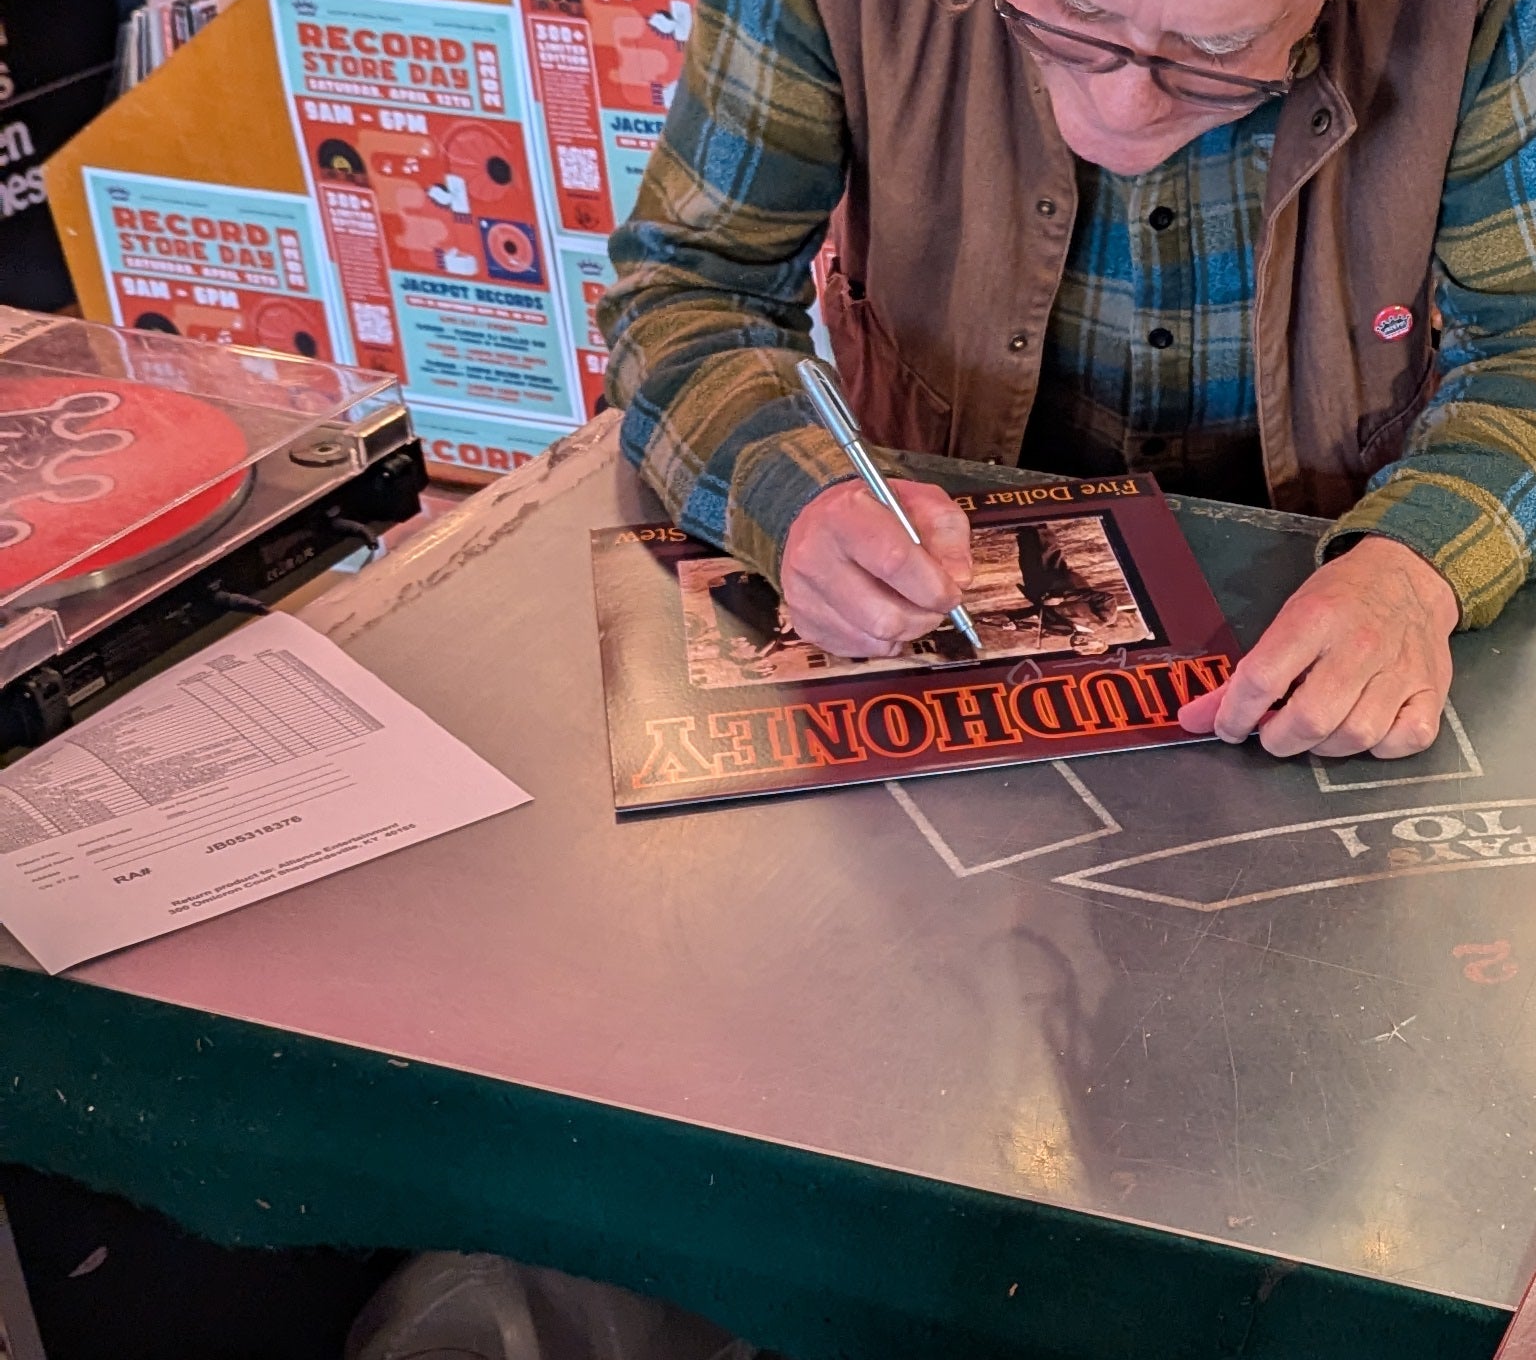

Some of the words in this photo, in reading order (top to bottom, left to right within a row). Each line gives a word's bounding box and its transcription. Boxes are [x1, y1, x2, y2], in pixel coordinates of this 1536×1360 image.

[296, 22, 466, 64] RECORD
[302, 51, 398, 81] STORE
[409, 64, 471, 90] DAY
[304, 100, 356, 126] 9AM
[379, 109, 429, 135] 6PM
[112, 206, 270, 247] RECORD
[119, 232, 208, 261] STORE
[219, 245, 275, 270] DAY
[120, 277, 171, 300] 9AM
[400, 276, 471, 300] JACKPOT
[475, 285, 544, 311] RECORDS
[994, 483, 1076, 507] Dollar
[1081, 477, 1140, 498] Five
[614, 526, 688, 546] Stew
[632, 654, 1233, 789] MUDHONEY
[1391, 810, 1523, 842] TO
[113, 867, 153, 885] RA#
[171, 890, 212, 908] Return
[214, 873, 259, 894] product
[278, 850, 322, 870] Alliance
[323, 822, 400, 853] Entertainment
[192, 886, 243, 908] Omicron
[244, 874, 278, 889] Court
[363, 836, 380, 846] KY
